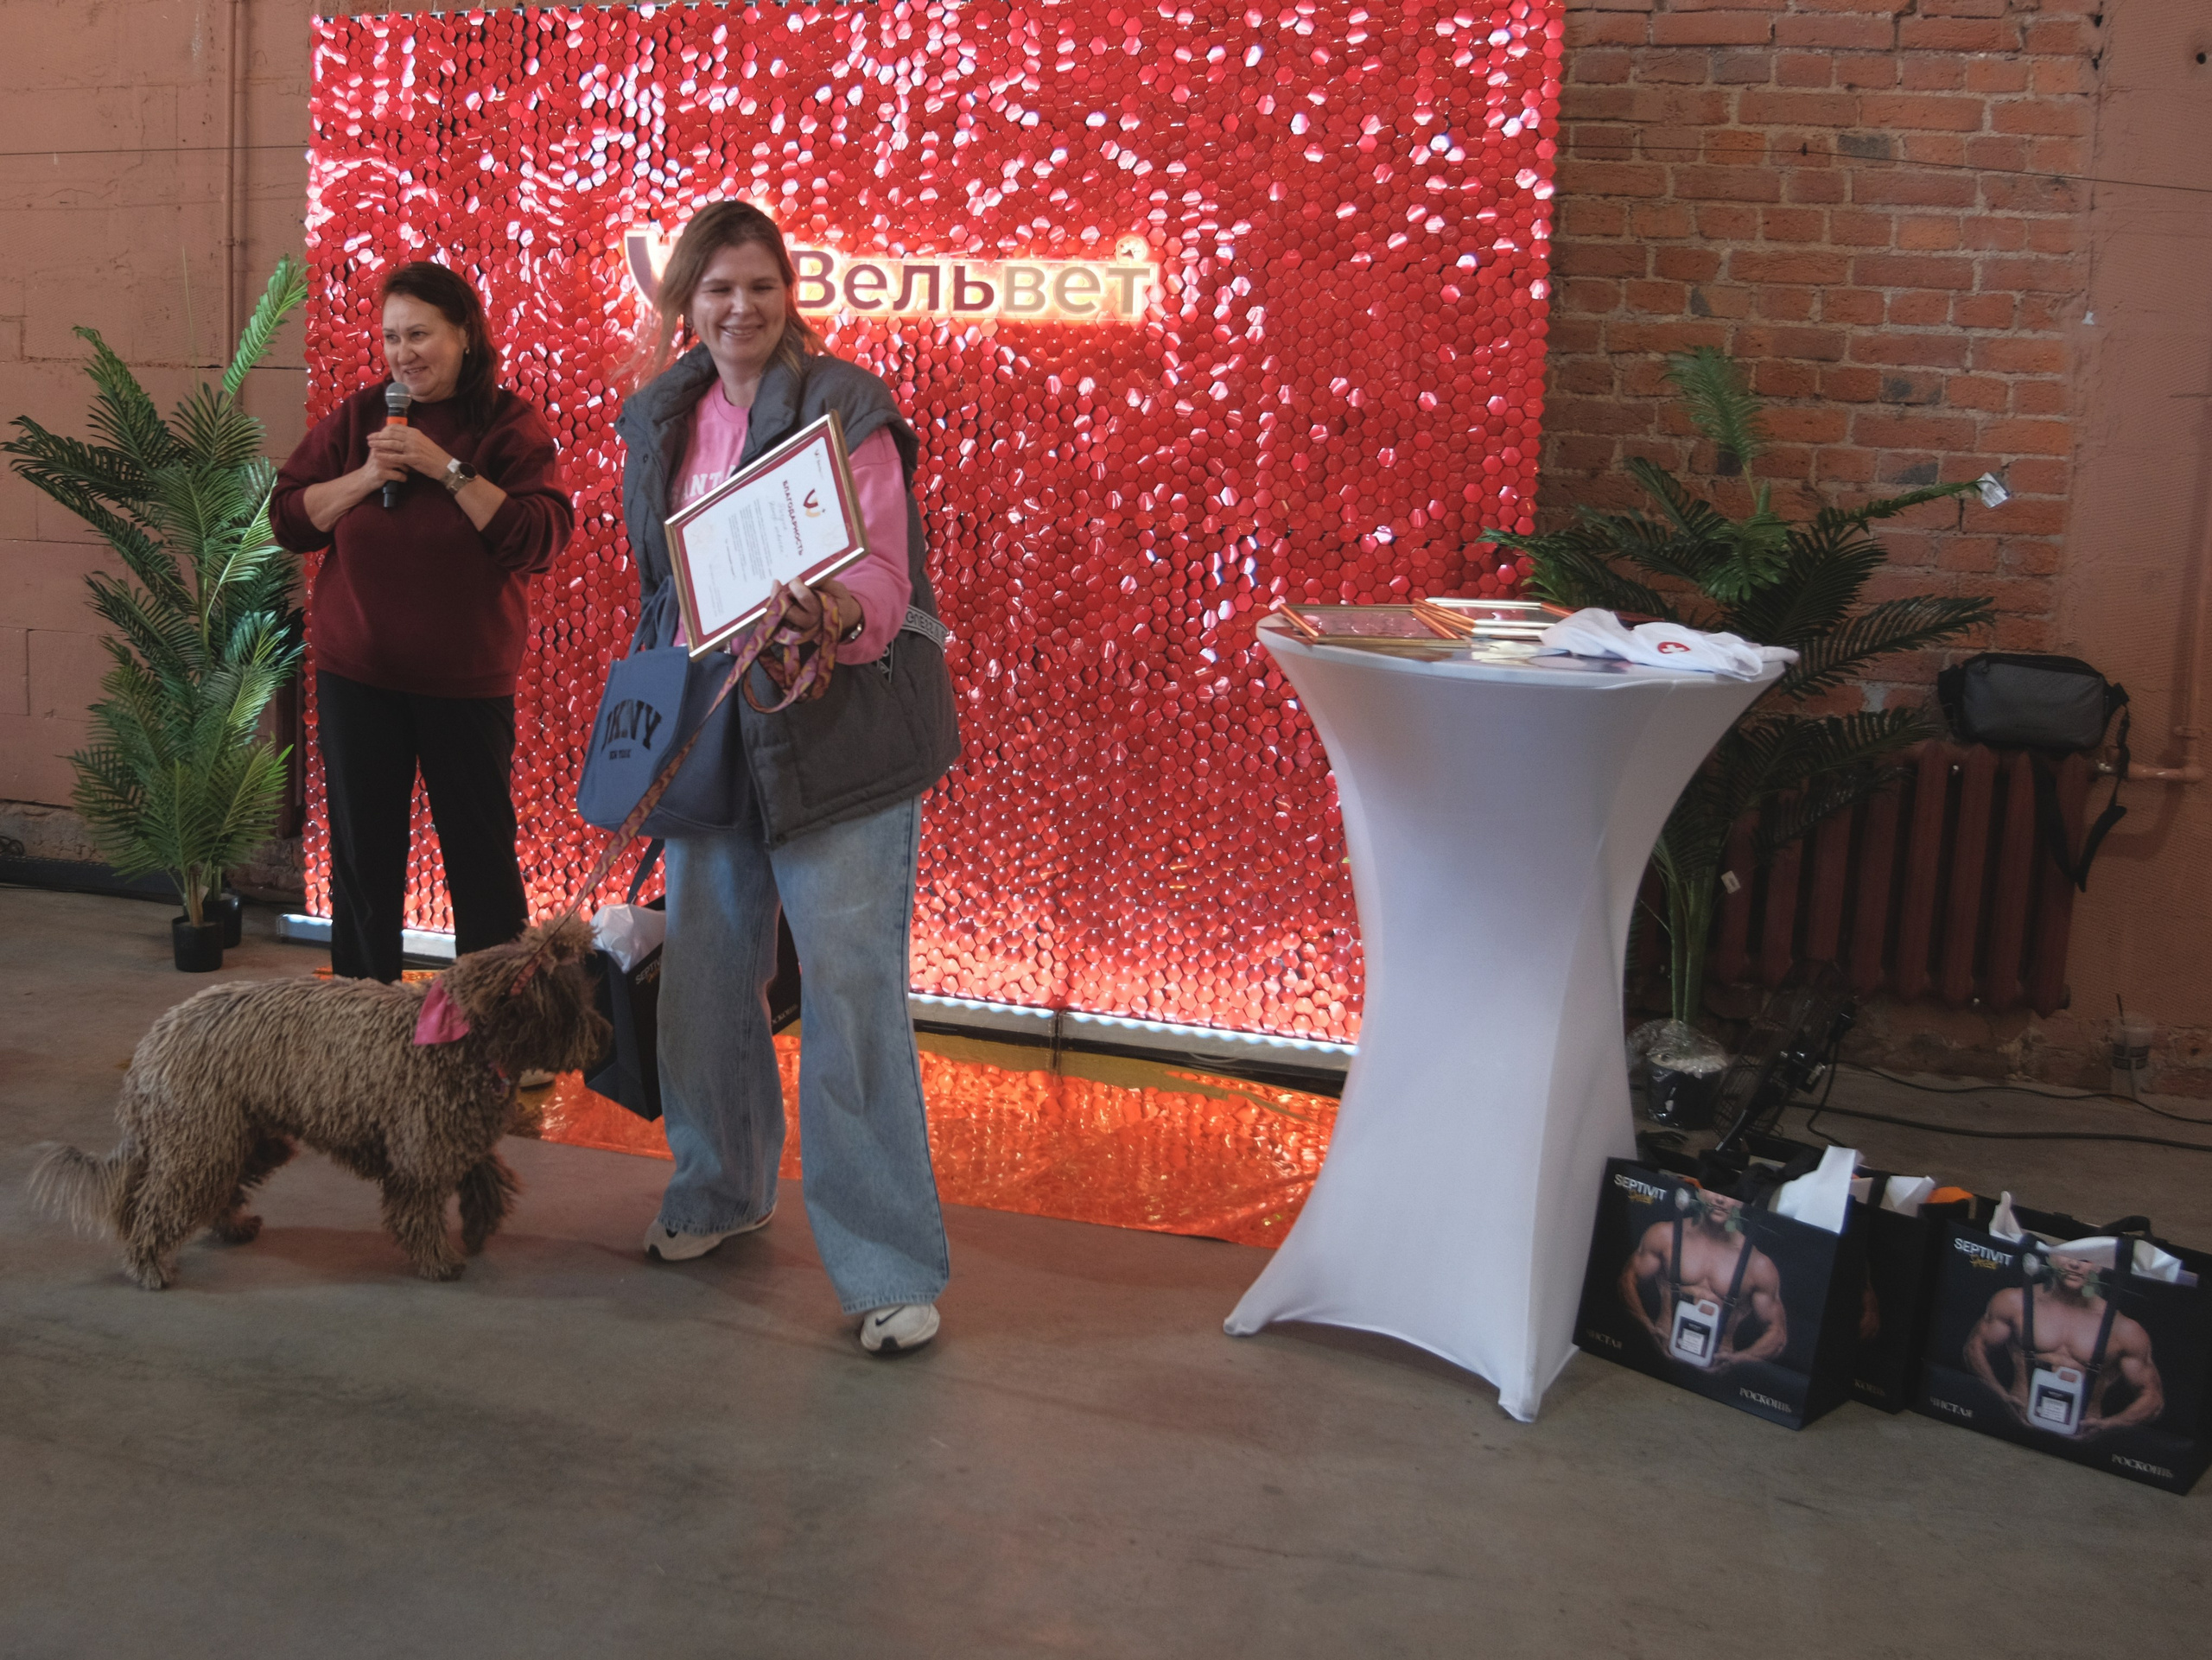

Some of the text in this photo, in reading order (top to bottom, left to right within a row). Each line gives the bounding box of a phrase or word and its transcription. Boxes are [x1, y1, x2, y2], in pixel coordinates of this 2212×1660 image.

[791, 249, 1153, 316] Вельвет
[782, 480, 804, 556] БЛАГОДАРНОСТЬ
[1953, 1237, 2013, 1267] SEPTIVIT
